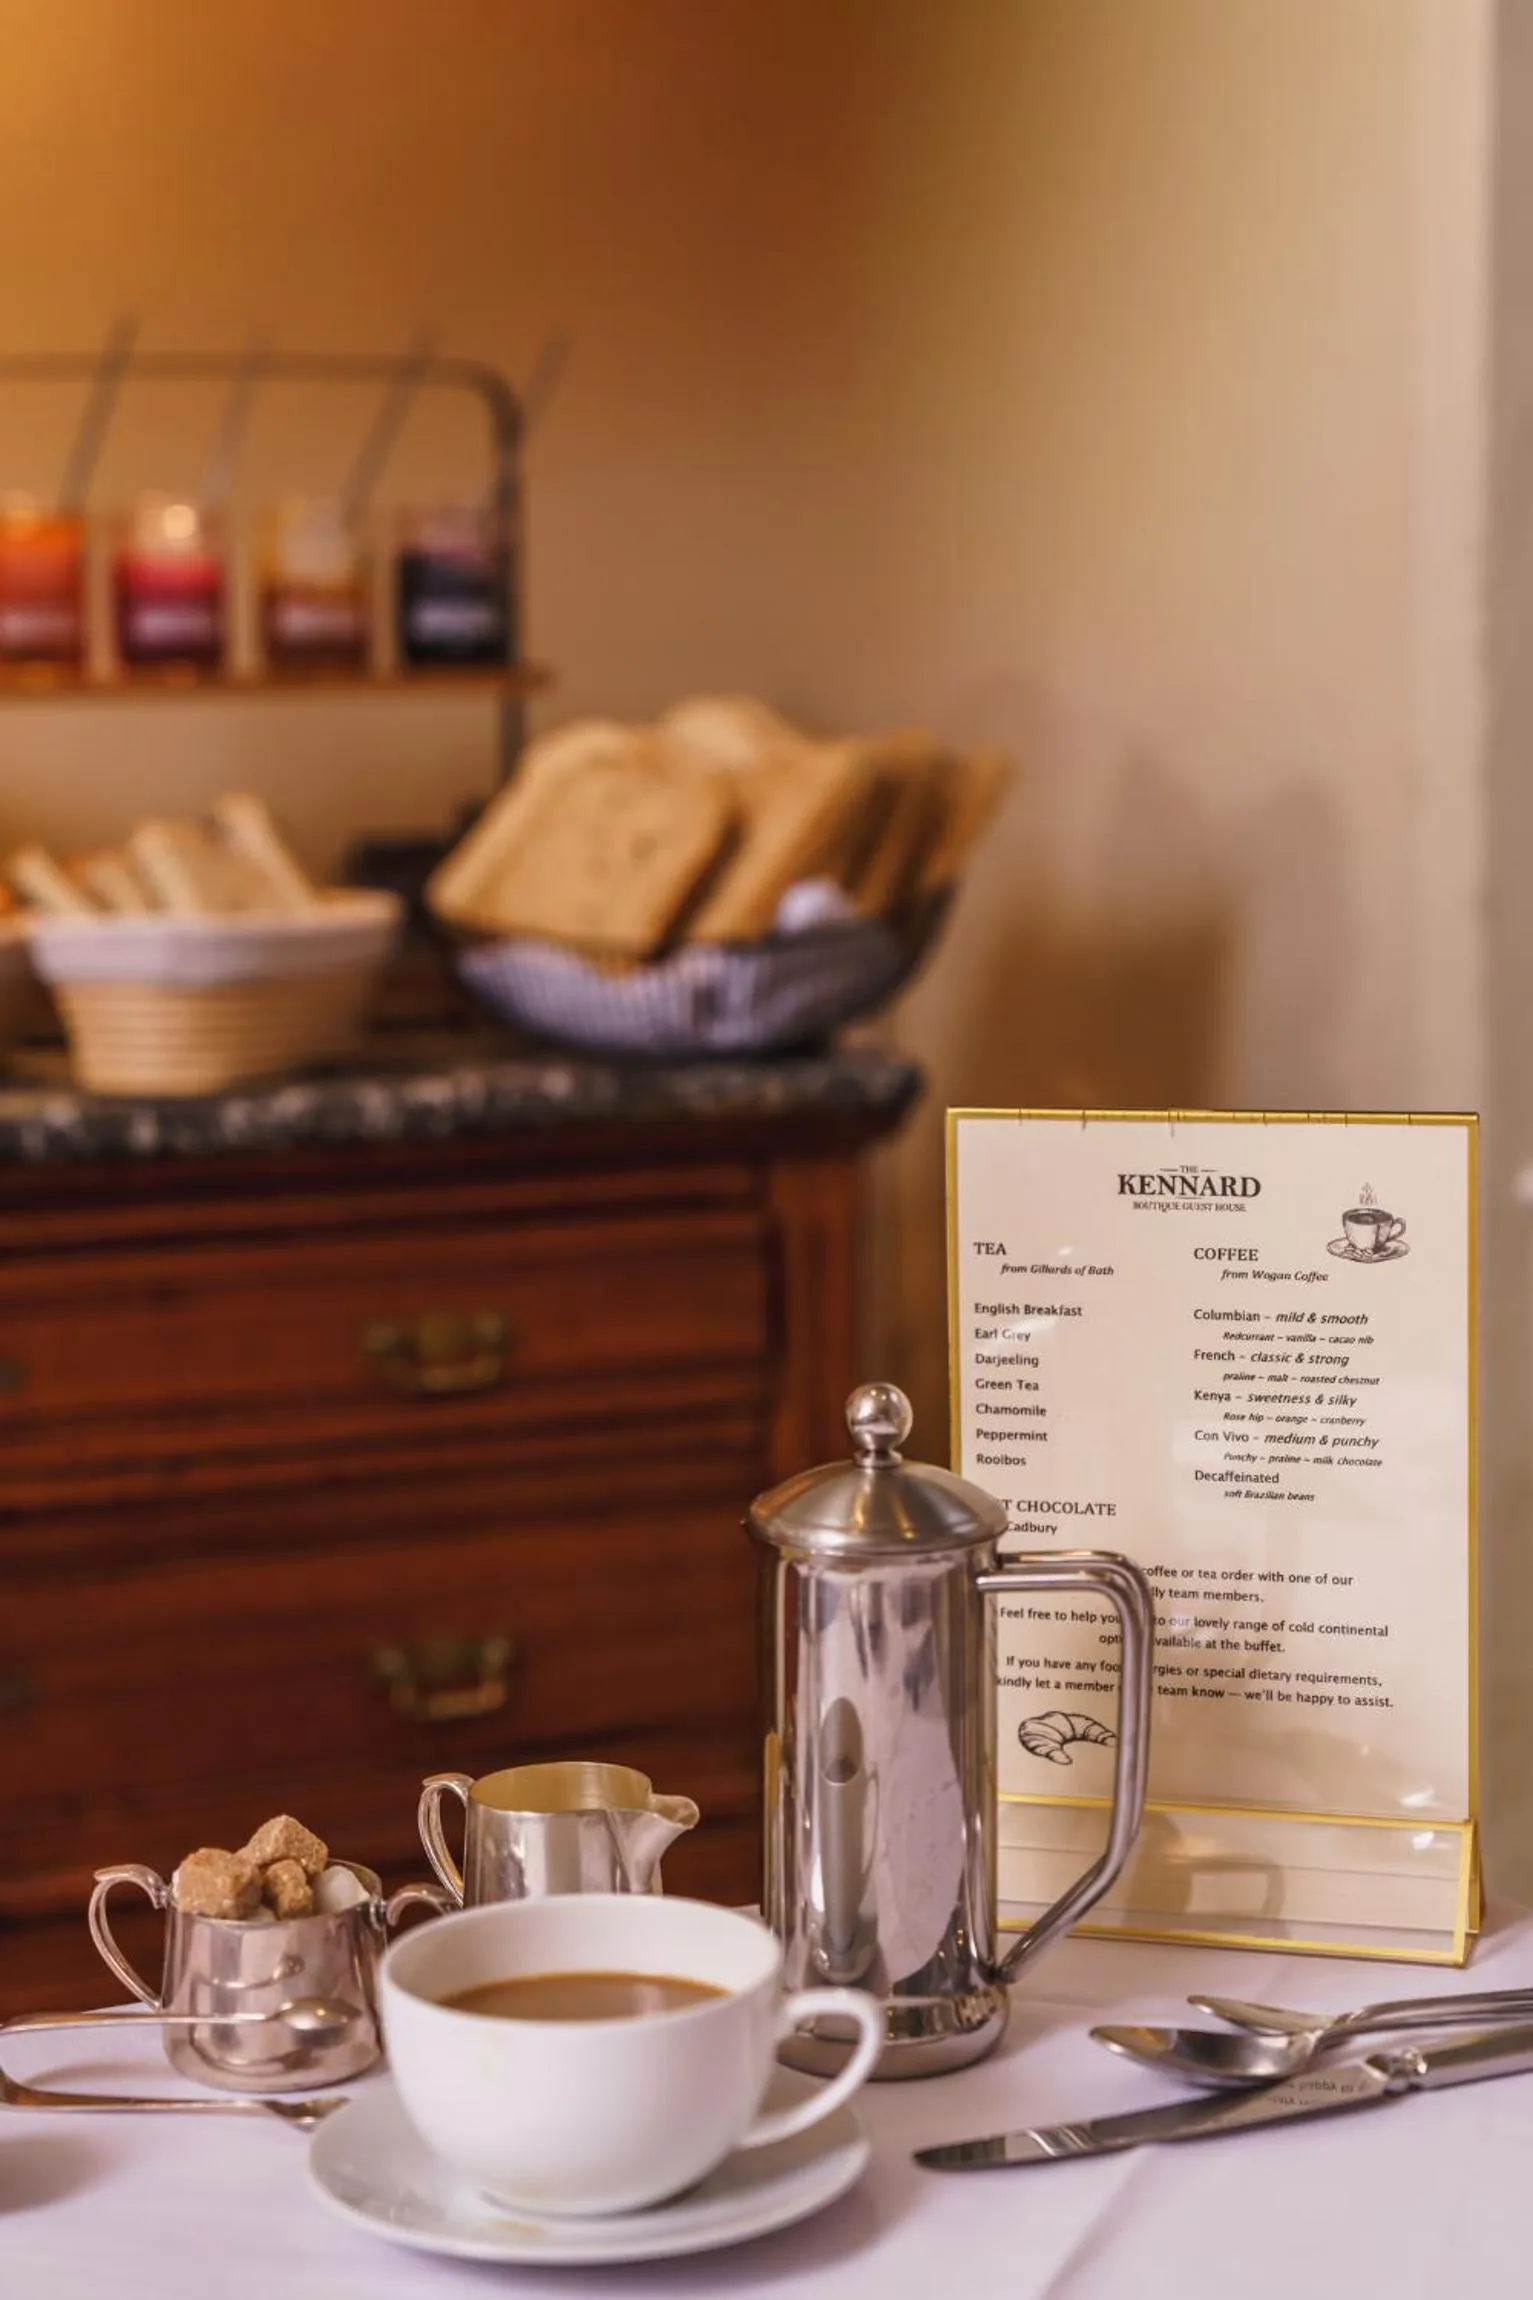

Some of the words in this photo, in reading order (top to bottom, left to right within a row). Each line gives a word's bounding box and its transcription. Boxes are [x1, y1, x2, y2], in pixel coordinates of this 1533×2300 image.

[1179, 1165, 1197, 1173] THE
[1117, 1174, 1262, 1198] KENNARD
[1132, 1200, 1181, 1213] BOUTIQUE
[1182, 1202, 1213, 1212] GUEST
[1215, 1203, 1247, 1213] HOUSE
[973, 1241, 1008, 1256] TEA
[1193, 1247, 1260, 1262] COFFEE
[1000, 1263, 1028, 1275] from
[1029, 1264, 1073, 1276] Gillards
[1074, 1267, 1087, 1278] of
[1087, 1266, 1115, 1277] Bath
[1220, 1268, 1249, 1282] from
[1252, 1270, 1292, 1282] Wogan
[1294, 1271, 1329, 1283] Coffee
[974, 1303, 1020, 1316] English
[1023, 1304, 1083, 1317] Breakfast
[1193, 1308, 1261, 1323] Columbian
[1275, 1311, 1305, 1324] mild
[1306, 1312, 1317, 1325] &
[1319, 1314, 1369, 1326] smooth
[975, 1328, 998, 1340] Earl
[1222, 1331, 1276, 1343] Redcurrant
[1286, 1333, 1318, 1343] vanilla
[1328, 1336, 1356, 1345] cacao
[1357, 1335, 1375, 1345] nib
[975, 1353, 1040, 1368] Darjeeling
[1193, 1349, 1236, 1362] French
[1250, 1351, 1293, 1364] classic
[1294, 1353, 1305, 1365] &
[1307, 1354, 1350, 1368] strong
[975, 1378, 1013, 1391] Green
[1017, 1379, 1039, 1391] Tea
[1222, 1371, 1257, 1383] praline
[1267, 1373, 1289, 1383] malt
[1299, 1375, 1337, 1385] roasted
[1338, 1375, 1381, 1386] chestnut
[1193, 1389, 1231, 1404] Kenya
[1246, 1392, 1312, 1405] sweetness
[1313, 1394, 1325, 1406] &
[1327, 1394, 1358, 1408] silky
[975, 1403, 1047, 1417] Chamomile
[1222, 1411, 1247, 1421] Rose
[1248, 1412, 1265, 1424] hip
[1275, 1415, 1309, 1426] orange
[1319, 1416, 1367, 1428] cranberry
[976, 1428, 1048, 1442] Peppermint
[1194, 1430, 1219, 1442] Con
[1222, 1430, 1250, 1443] Vivo
[1263, 1432, 1316, 1446] medium
[1318, 1434, 1329, 1446] &
[1331, 1434, 1380, 1449] punchy
[976, 1453, 1027, 1467] Rooibos
[1223, 1451, 1258, 1464] Punchy
[1267, 1454, 1302, 1465] praline
[1312, 1456, 1334, 1466] milk
[1336, 1456, 1383, 1467] chocolate
[1194, 1470, 1280, 1484] Decaffeinated
[1223, 1489, 1243, 1499] soft
[1243, 1490, 1286, 1501] Brazilian
[1286, 1491, 1316, 1502] beans
[1016, 1499, 1117, 1517] CHOCOLATE
[1180, 1569, 1195, 1579] or
[1197, 1569, 1217, 1580] tea
[1220, 1568, 1254, 1581] order
[1257, 1570, 1285, 1582] with
[1288, 1573, 1312, 1584] one
[1314, 1572, 1329, 1584] of
[1331, 1575, 1354, 1586] our
[1168, 1586, 1199, 1599] team
[1202, 1589, 1265, 1603] members.
[1000, 1606, 1024, 1619] Feel
[1027, 1607, 1052, 1620] free
[1055, 1610, 1068, 1621] to
[1070, 1609, 1098, 1624] help
[1168, 1616, 1190, 1627] our
[1193, 1617, 1230, 1630] lovely
[1233, 1620, 1269, 1632] range
[1271, 1619, 1285, 1632] of
[1288, 1621, 1315, 1633] cold
[1317, 1623, 1389, 1637] continental
[1151, 1635, 1202, 1649] vailable
[1204, 1638, 1218, 1650] at
[1220, 1638, 1241, 1651] the
[1243, 1639, 1286, 1653] buffet.
[1006, 1655, 1015, 1666] If
[1018, 1658, 1041, 1671] you
[1043, 1657, 1071, 1670] have
[1075, 1661, 1097, 1673] any
[1099, 1660, 1122, 1673] foo
[1185, 1666, 1199, 1677] or
[1203, 1666, 1246, 1681] special
[1248, 1669, 1291, 1683] dietary
[1035, 1677, 1051, 1689] let
[1053, 1681, 1061, 1690] a
[1064, 1680, 1116, 1693] member
[1157, 1684, 1188, 1697] team
[1191, 1685, 1226, 1699] know
[1276, 1691, 1293, 1703] be
[1295, 1693, 1334, 1707] happy
[1337, 1695, 1351, 1706] to
[1354, 1696, 1395, 1709] assist.
